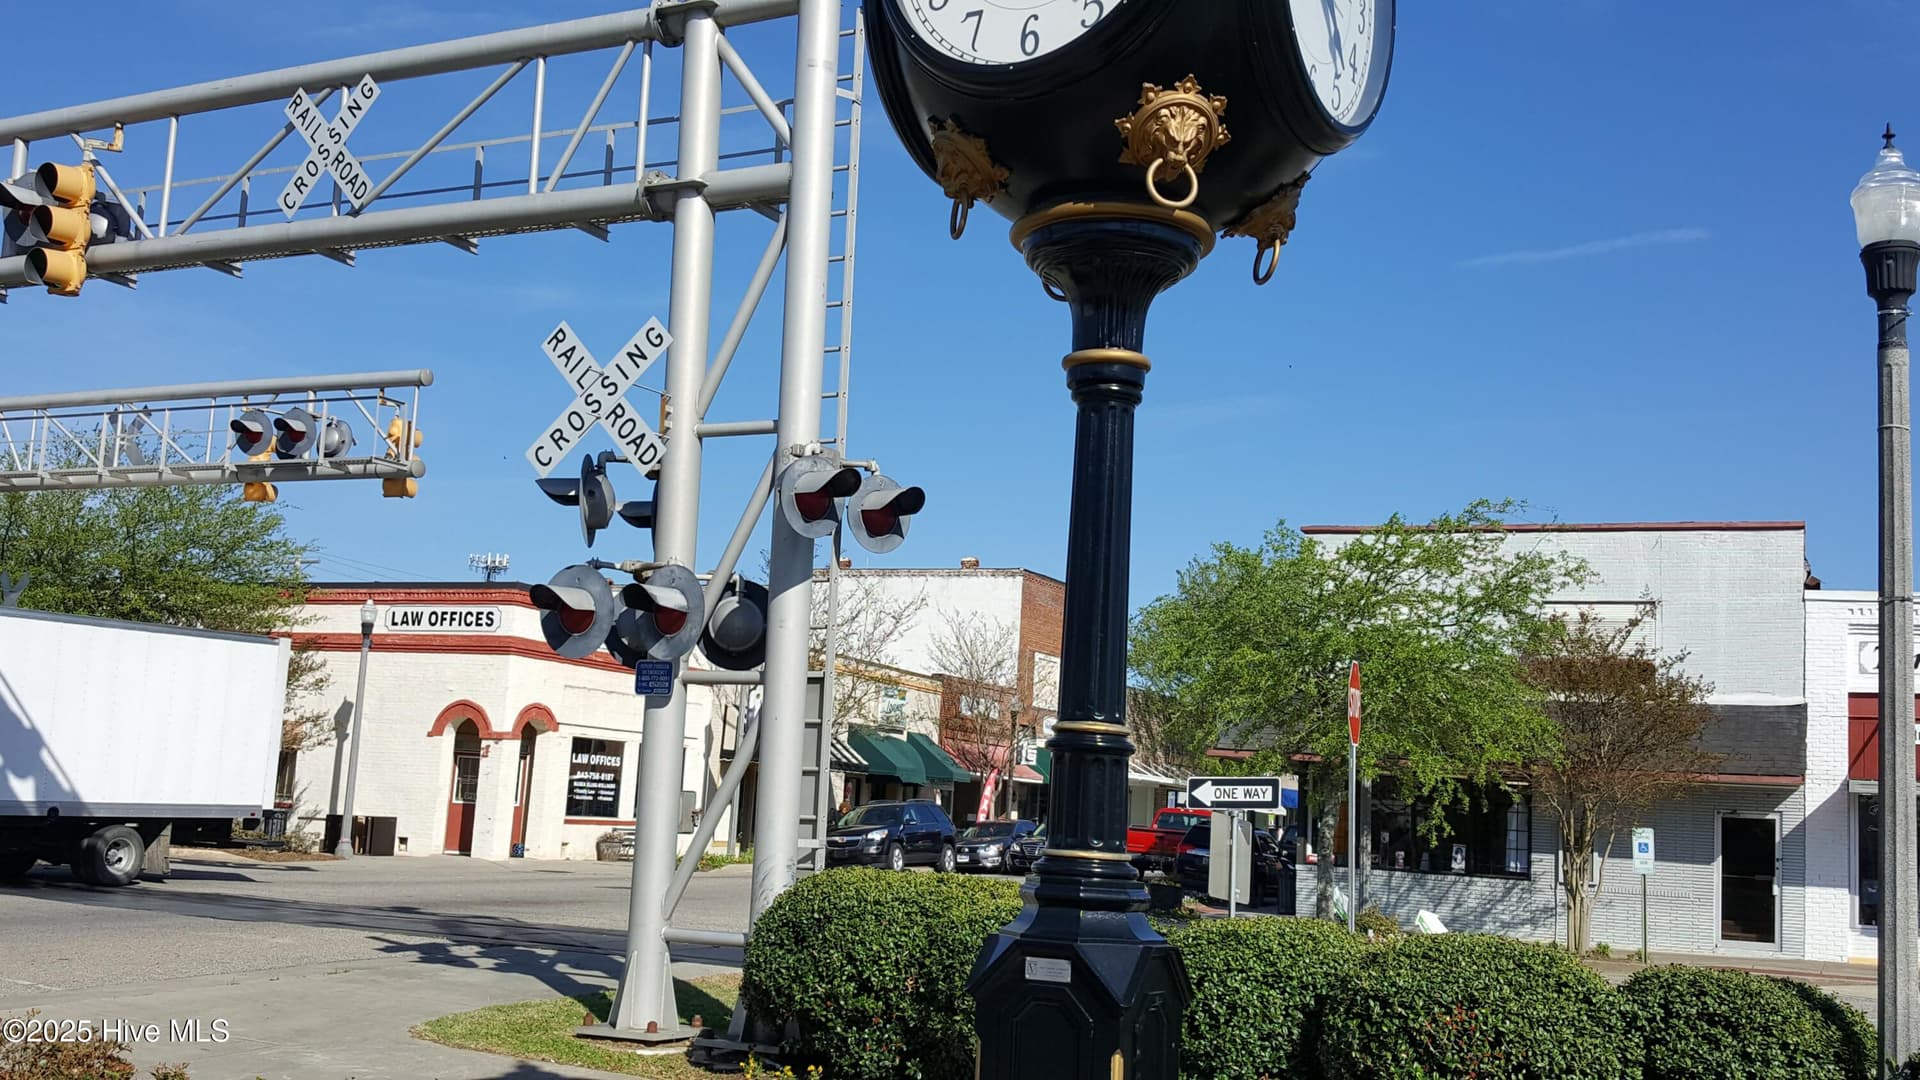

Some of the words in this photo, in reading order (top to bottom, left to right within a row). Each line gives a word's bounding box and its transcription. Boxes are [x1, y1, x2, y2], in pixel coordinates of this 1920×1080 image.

[960, 9, 984, 52] 7
[1020, 14, 1040, 56] 6
[1357, 0, 1366, 34] 3
[1349, 43, 1358, 84] 4
[283, 82, 374, 210] CROSSING
[288, 94, 322, 143] RAIL
[331, 151, 368, 200] ROAD
[535, 327, 664, 467] CROSSING
[547, 328, 592, 390] RAIL
[605, 403, 658, 466] ROAD
[391, 611, 424, 627] LAW
[428, 611, 495, 627] OFFICES
[572, 752, 589, 764] LAW
[590, 754, 621, 767] OFFICES
[1214, 788, 1238, 799] ONE
[1243, 788, 1269, 799] WAY
